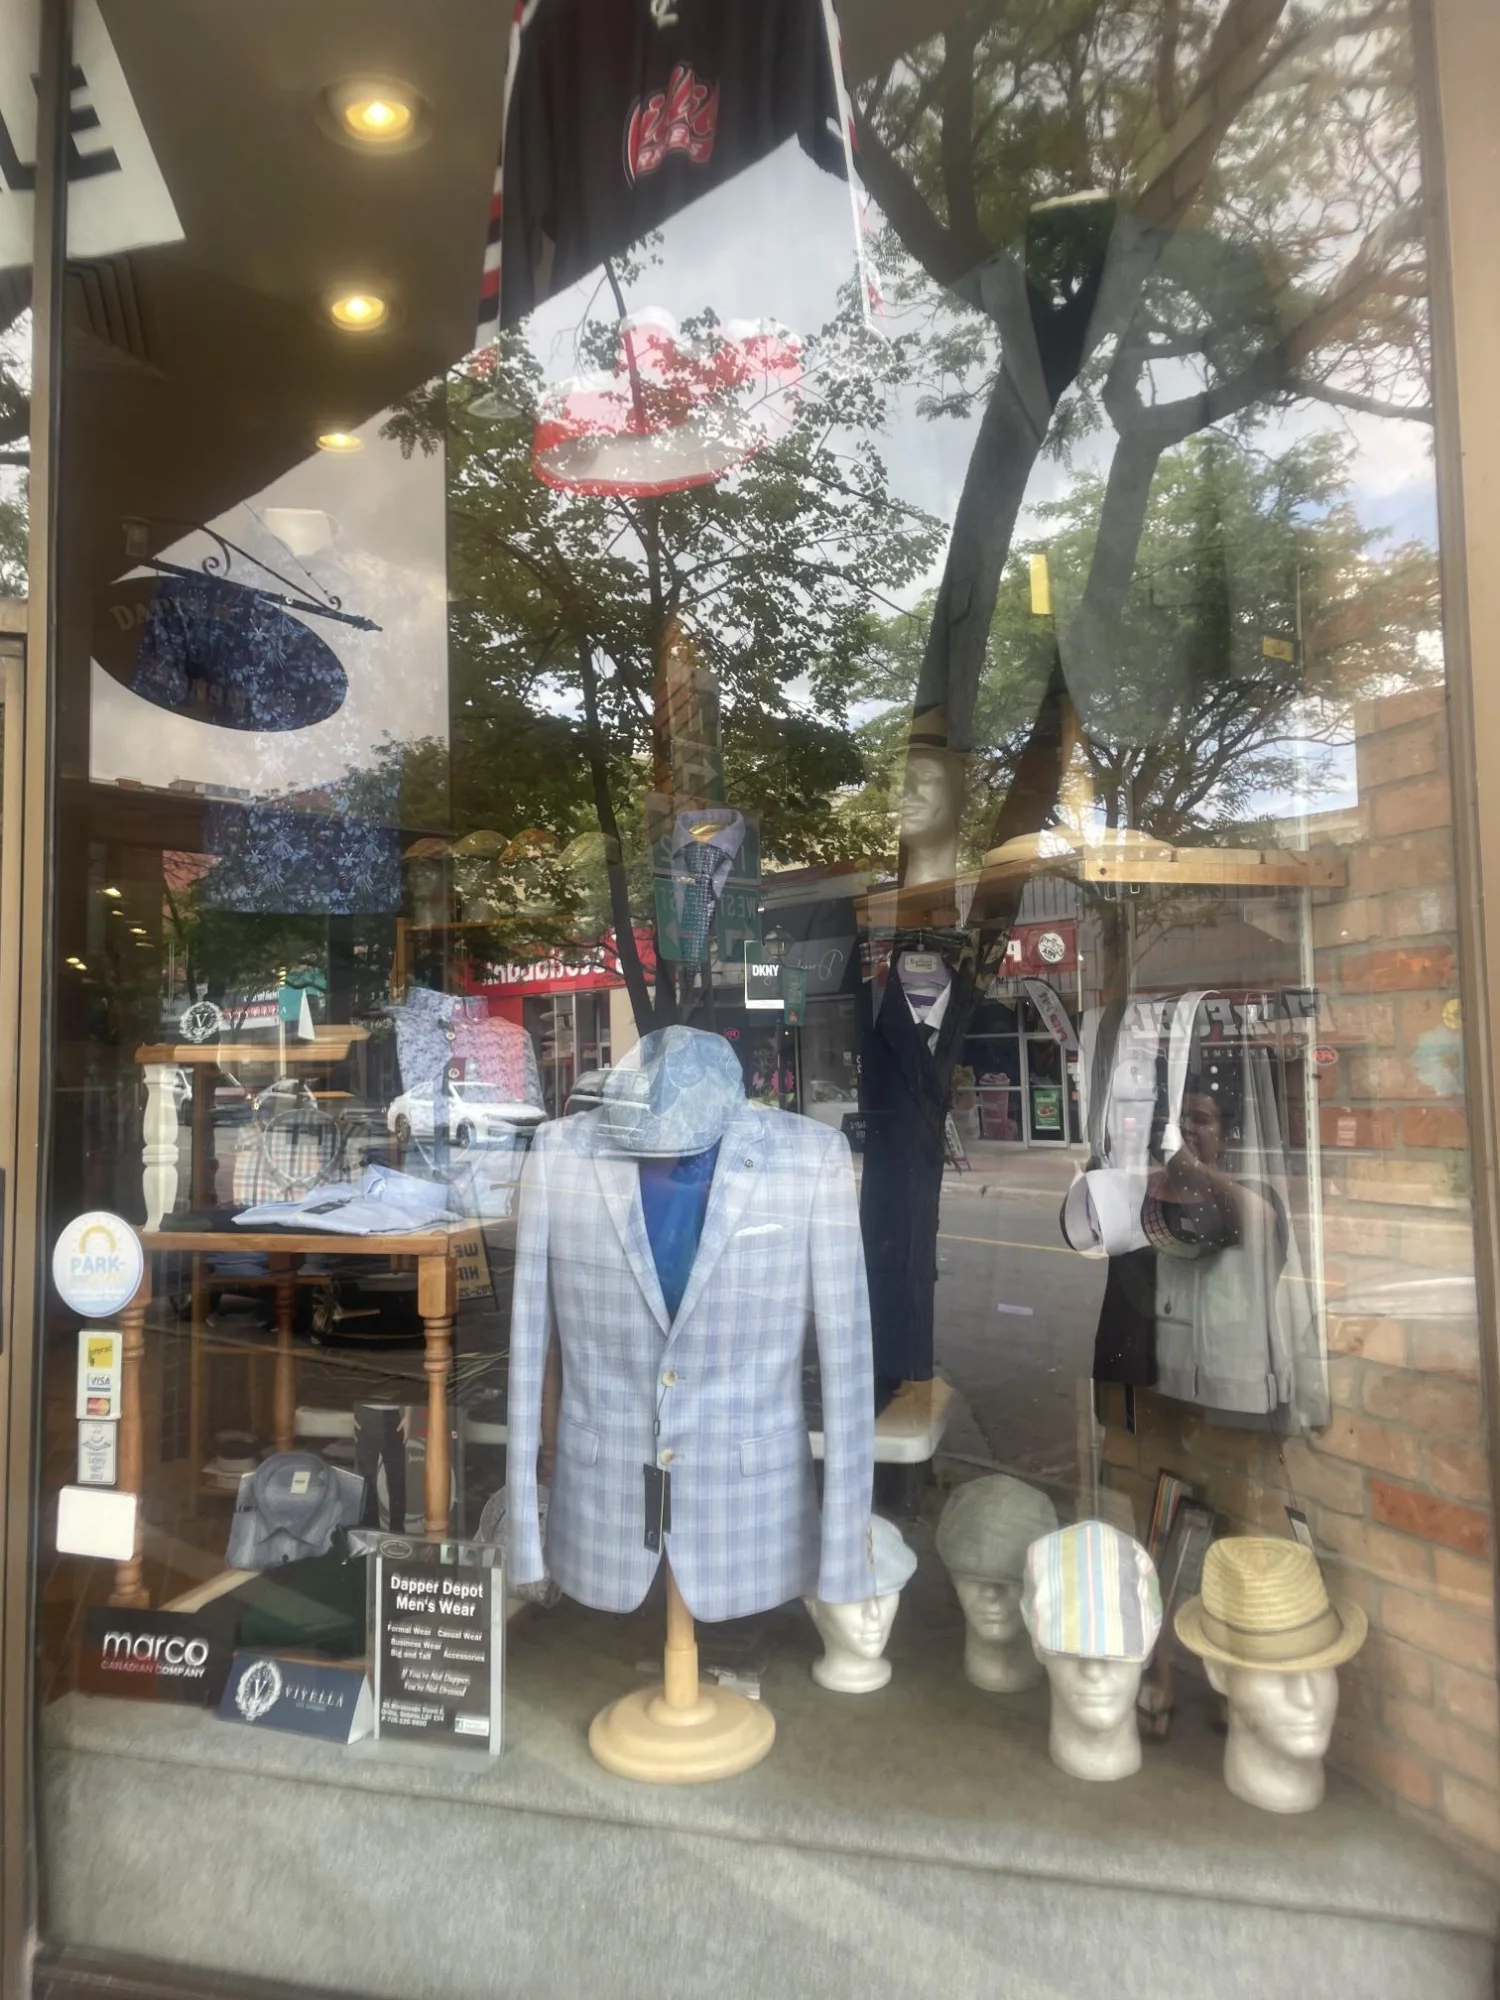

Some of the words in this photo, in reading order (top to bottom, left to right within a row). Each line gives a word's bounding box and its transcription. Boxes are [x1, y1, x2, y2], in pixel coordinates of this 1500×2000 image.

[752, 964, 779, 978] DKNY
[91, 1376, 111, 1386] VISA
[390, 1575, 440, 1595] Dapper
[442, 1580, 483, 1600] Depot
[396, 1594, 436, 1614] Men's
[439, 1599, 476, 1617] Wear
[387, 1624, 411, 1635] Formal
[413, 1626, 431, 1636] Wear
[437, 1629, 461, 1640] Casual
[463, 1632, 482, 1642] Wear
[102, 1631, 209, 1667] marco
[390, 1637, 421, 1649] Business
[423, 1640, 442, 1651] Wear
[390, 1649, 402, 1659] Big
[403, 1650, 417, 1660] and
[443, 1650, 485, 1663] Accessories
[101, 1660, 154, 1676] CANADIAN
[155, 1665, 206, 1679] COMPANY
[285, 1684, 344, 1708] VIYELLA
